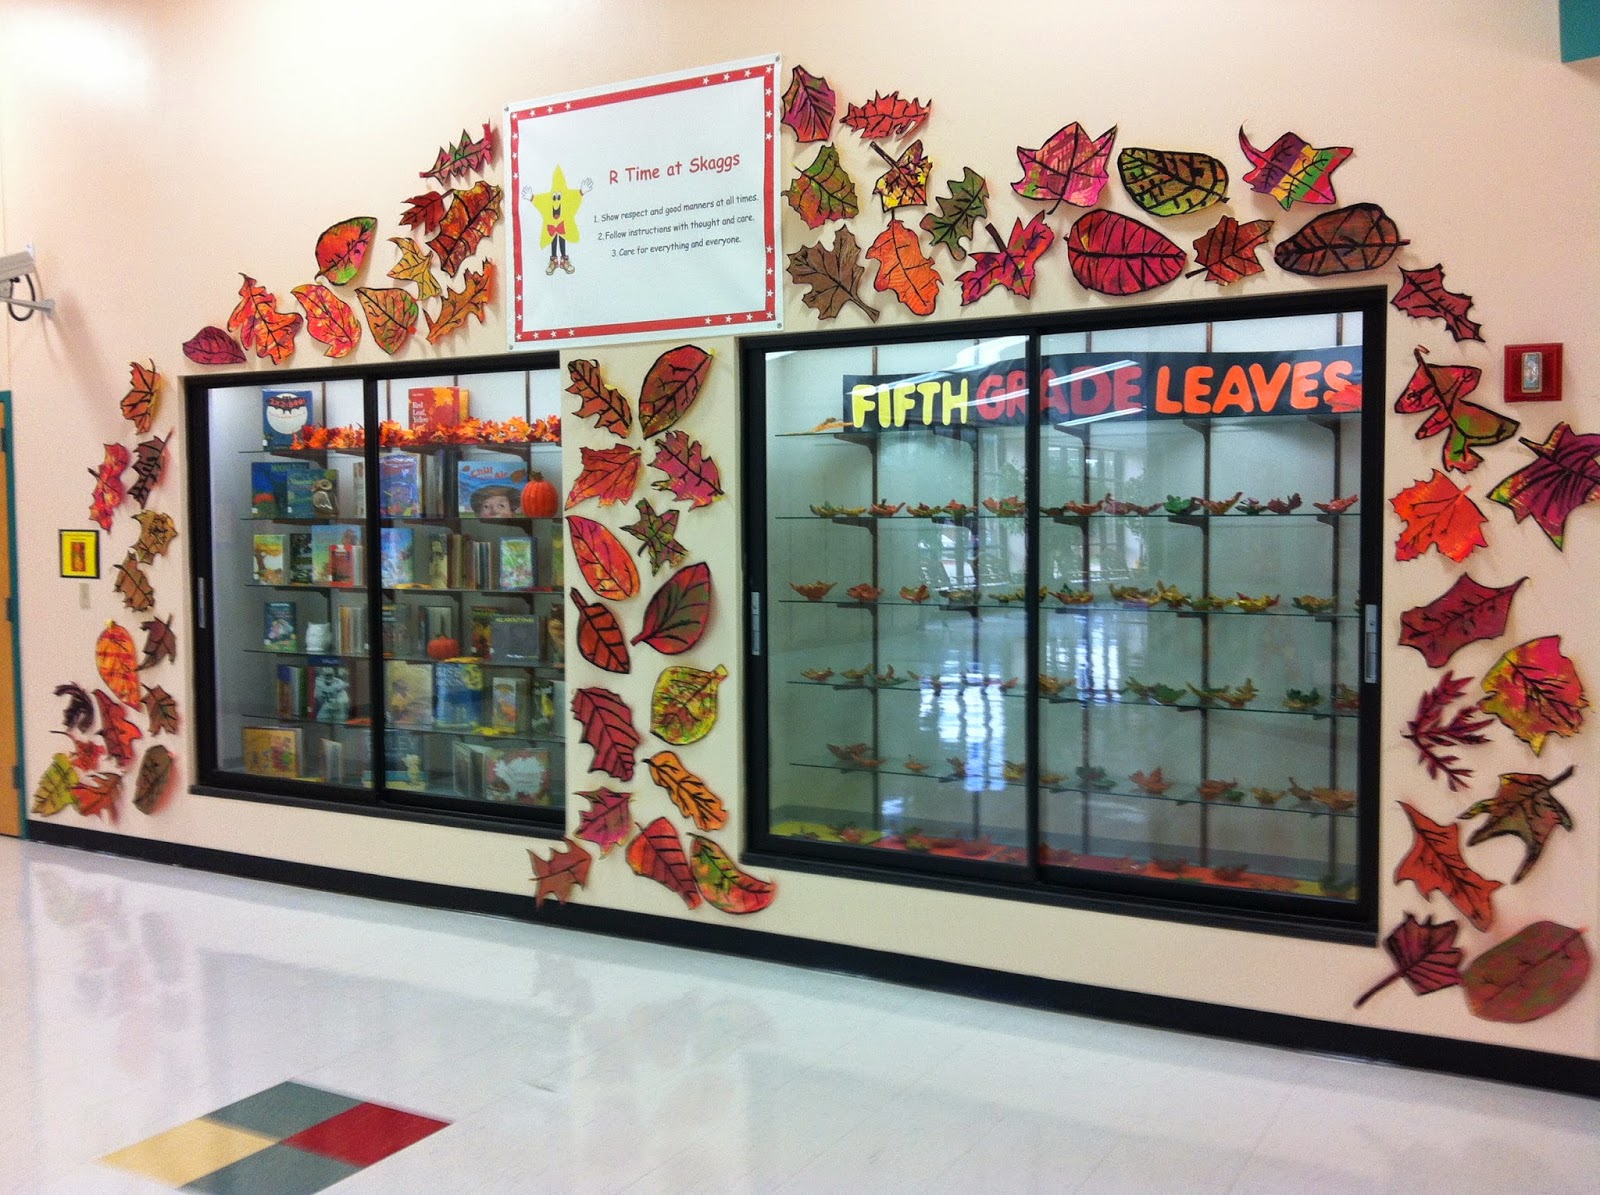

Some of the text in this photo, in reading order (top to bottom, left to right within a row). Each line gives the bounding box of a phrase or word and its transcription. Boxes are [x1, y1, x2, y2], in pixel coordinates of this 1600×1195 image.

[609, 154, 740, 185] R Time at Skaggs
[601, 213, 620, 222] Show
[620, 209, 648, 220] respect
[650, 206, 664, 216] and
[665, 204, 682, 216] good
[683, 200, 715, 211] manners
[716, 198, 724, 207] at
[726, 195, 735, 206] all
[736, 194, 759, 203] times.
[598, 214, 755, 241] 2. Follow instructions with thought and care.
[618, 248, 635, 257] Care
[637, 245, 648, 255] for
[650, 242, 690, 253] everything
[691, 238, 704, 248] and
[705, 236, 742, 247] everyone.
[852, 360, 1353, 428] FIFTH GRADE LEAVES
